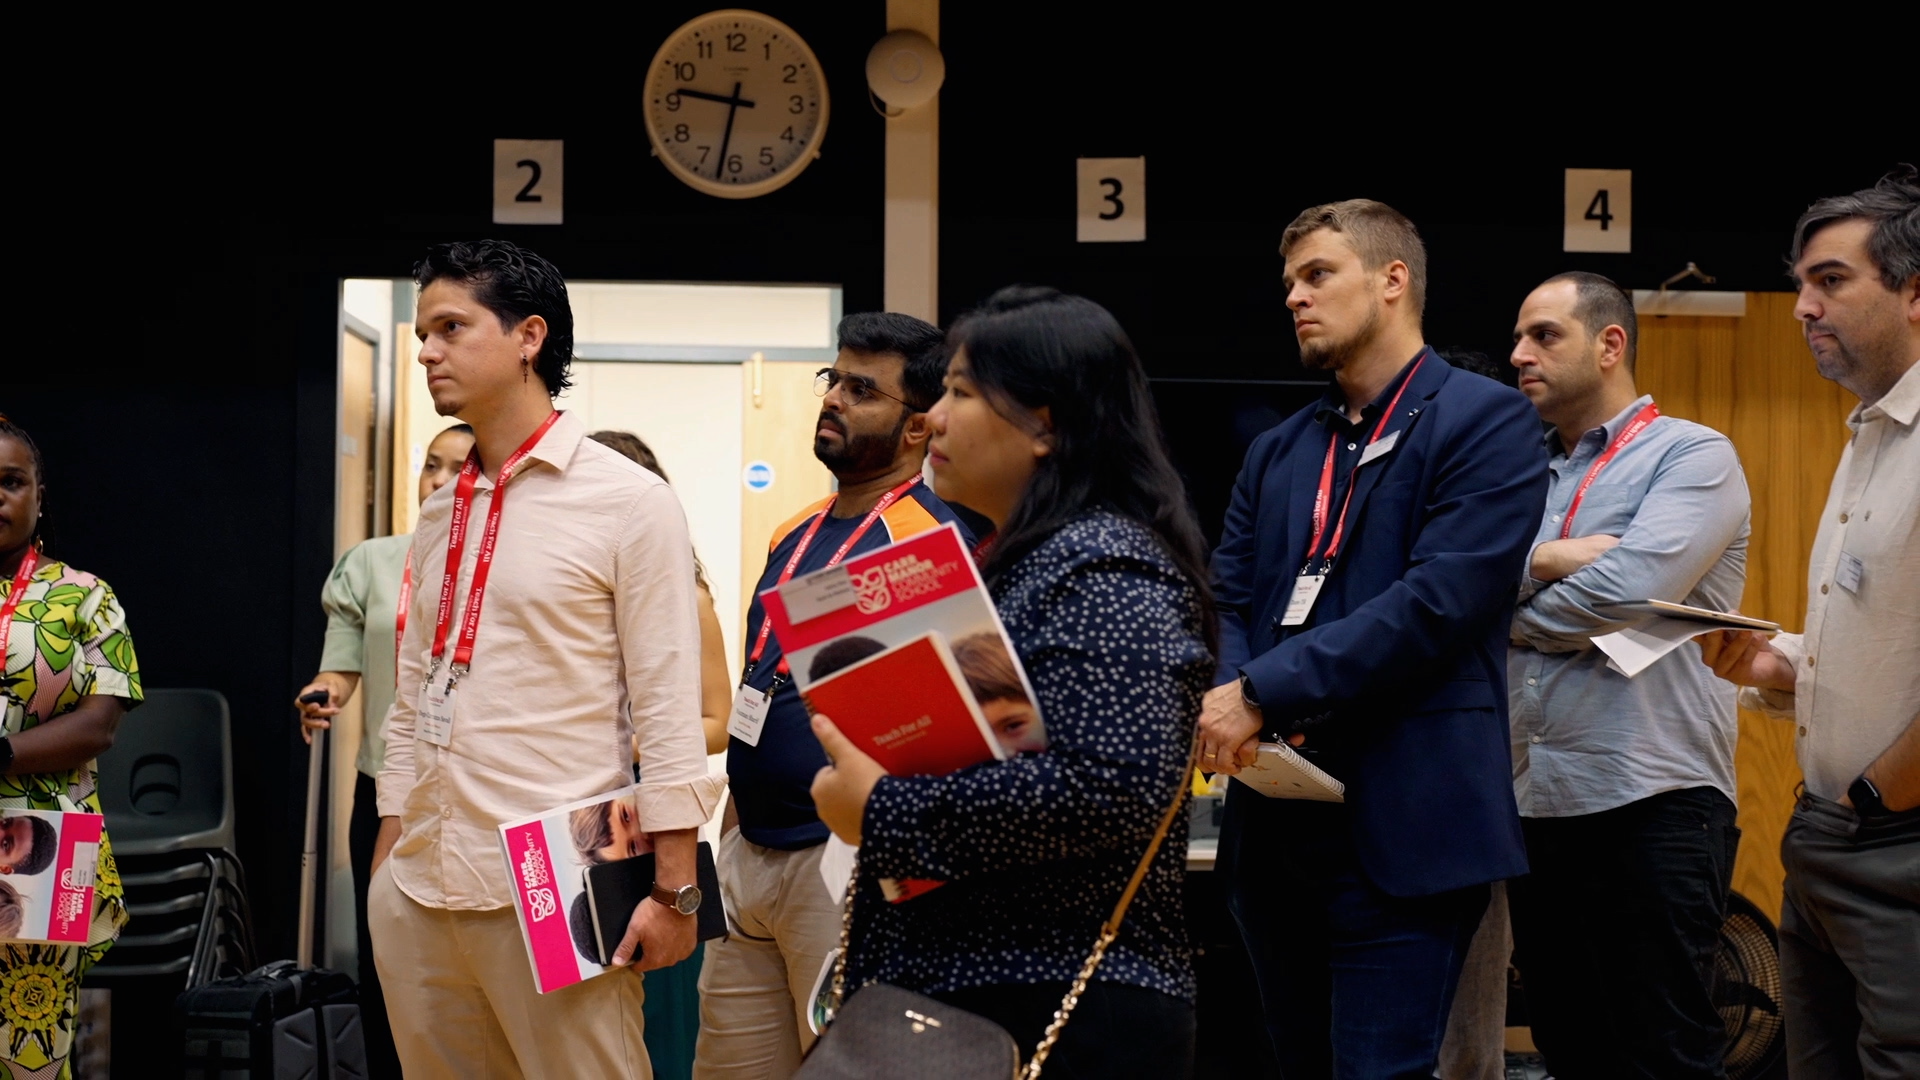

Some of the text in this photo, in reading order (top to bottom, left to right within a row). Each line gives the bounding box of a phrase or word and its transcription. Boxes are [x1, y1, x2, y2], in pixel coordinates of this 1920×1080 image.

[697, 41, 712, 59] 11
[725, 33, 747, 52] 12
[763, 42, 770, 61] 1
[673, 62, 696, 82] 10
[782, 64, 797, 84] 2
[665, 92, 681, 112] 9
[788, 95, 804, 114] 3
[674, 123, 690, 143] 8
[780, 126, 794, 144] 4
[696, 146, 711, 165] 7
[727, 155, 742, 174] 6
[759, 147, 774, 166] 5
[515, 159, 542, 203] 2
[1099, 177, 1124, 221] 3
[1584, 188, 1613, 231] 4
[883, 491, 895, 502] All
[1313, 500, 1321, 513] For
[450, 497, 464, 550] Teach For All
[489, 511, 499, 535] Teach
[1312, 513, 1320, 536] Teach
[486, 536, 494, 550] For
[483, 551, 491, 562] All
[438, 602, 446, 626] Teach
[466, 587, 482, 639] Teach For All
[525, 832, 543, 885] COMMUNITY
[536, 847, 549, 884] SCHOOL
[521, 862, 531, 888] CARR
[524, 851, 538, 887] MANOR
